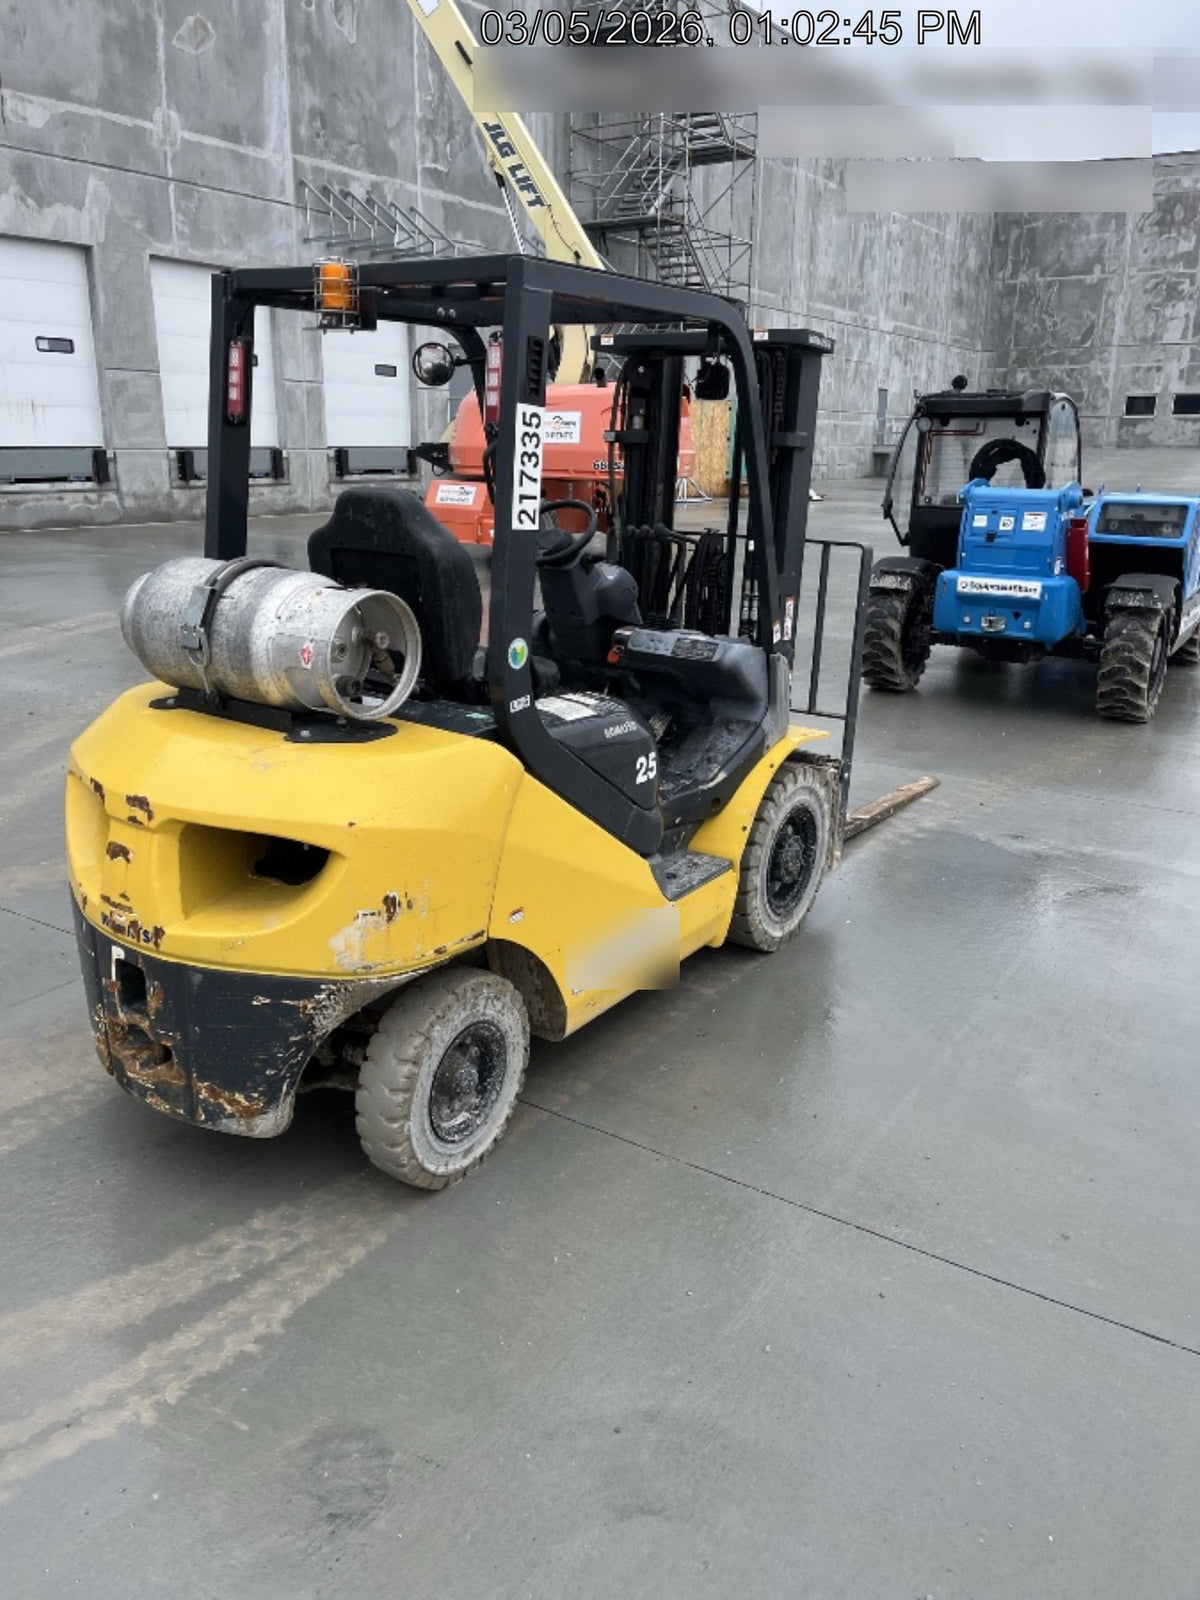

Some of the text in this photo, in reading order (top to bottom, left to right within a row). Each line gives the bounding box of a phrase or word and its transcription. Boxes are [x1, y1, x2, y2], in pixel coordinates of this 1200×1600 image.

[482, 122, 546, 207] JLG LIFT
[517, 411, 541, 525] 217335
[636, 752, 656, 785] 25
